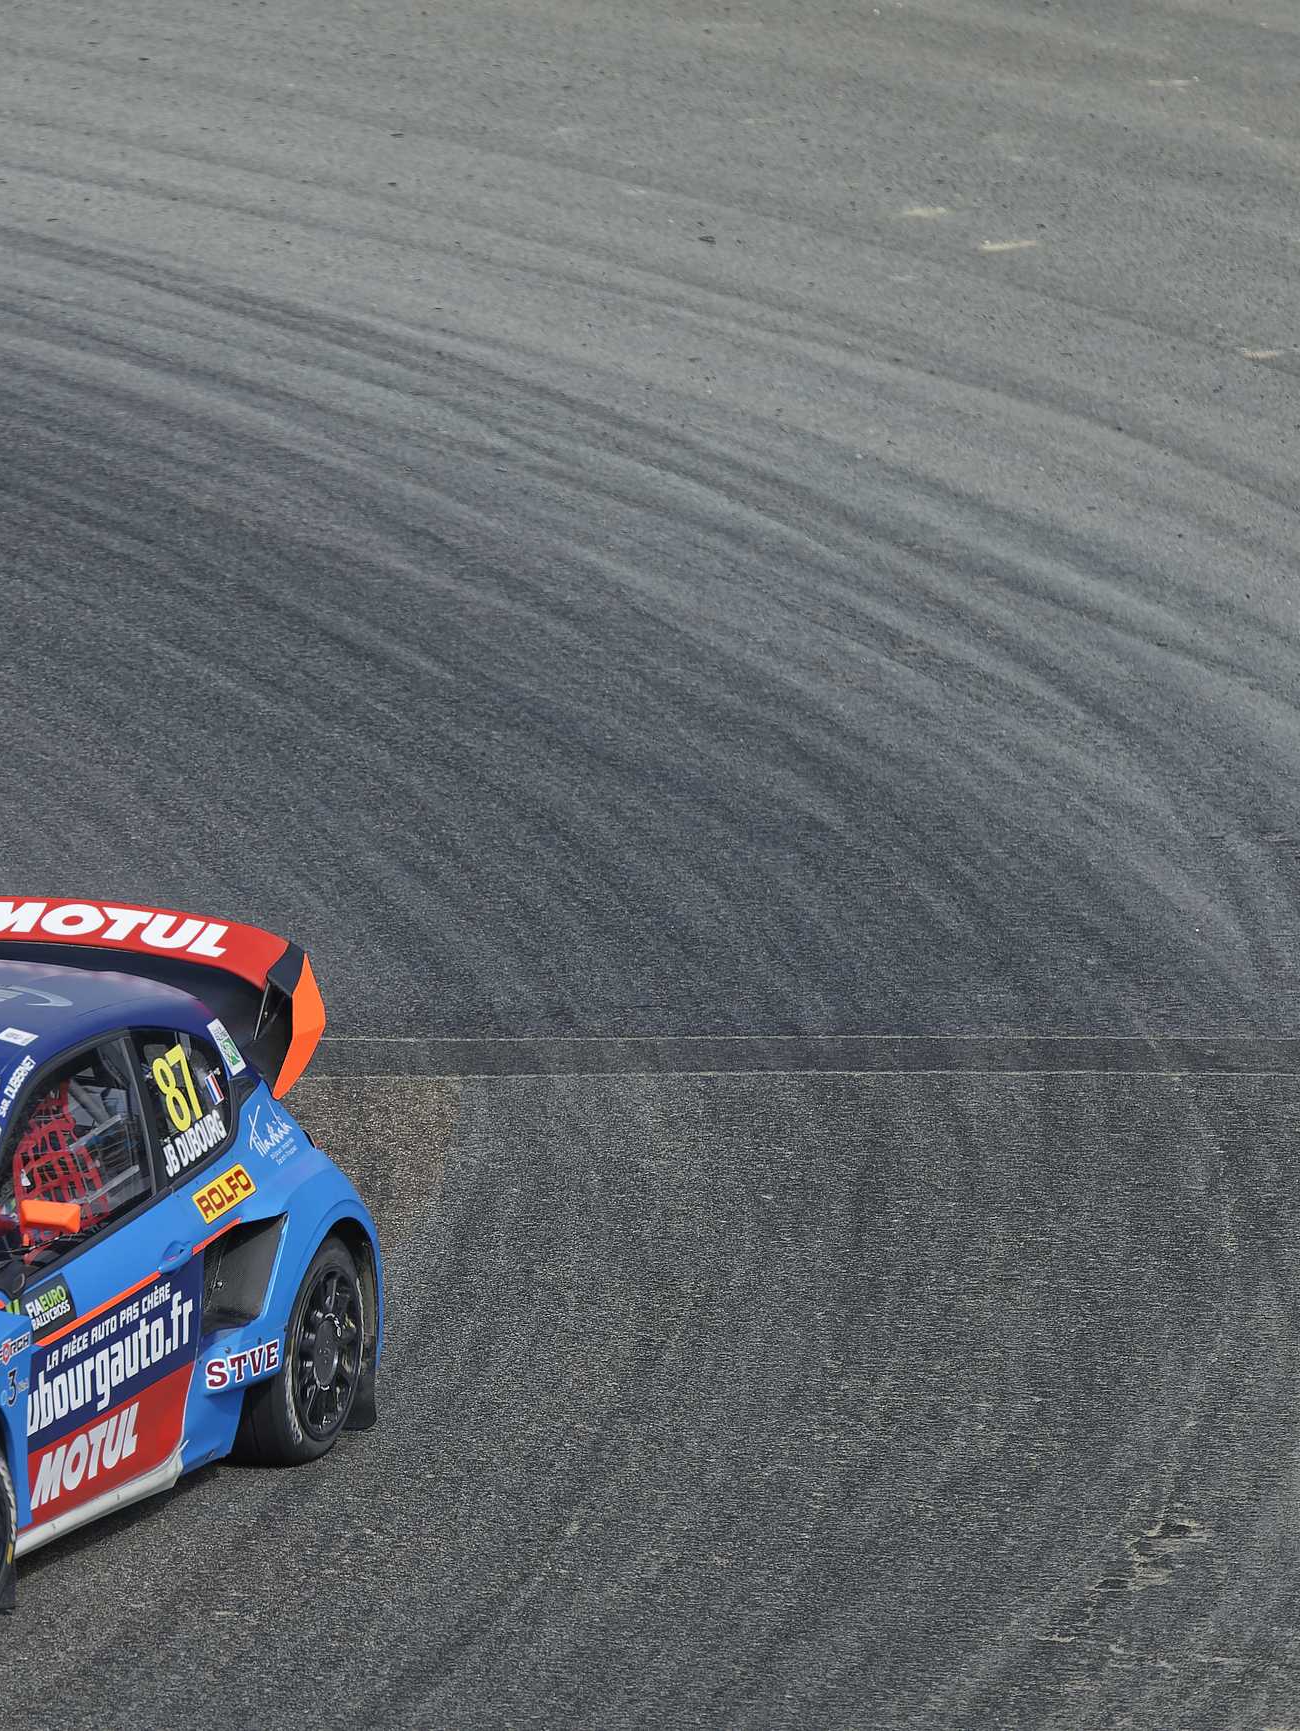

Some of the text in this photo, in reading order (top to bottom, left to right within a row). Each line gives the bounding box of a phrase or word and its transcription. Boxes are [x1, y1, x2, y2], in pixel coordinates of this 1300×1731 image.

[152, 1043, 203, 1133] 87
[162, 1143, 182, 1178] JB
[174, 1109, 228, 1168] DUBOURG
[196, 1169, 252, 1219] ROLFO
[25, 1298, 44, 1319] FIA
[39, 1285, 67, 1312] EURO
[31, 1299, 71, 1331] RALLYCROSS
[46, 1281, 171, 1371] LA PIÈCE AUTO PAS CHÈRE
[206, 1339, 279, 1389] STVE
[30, 1401, 140, 1511] MOTUL
